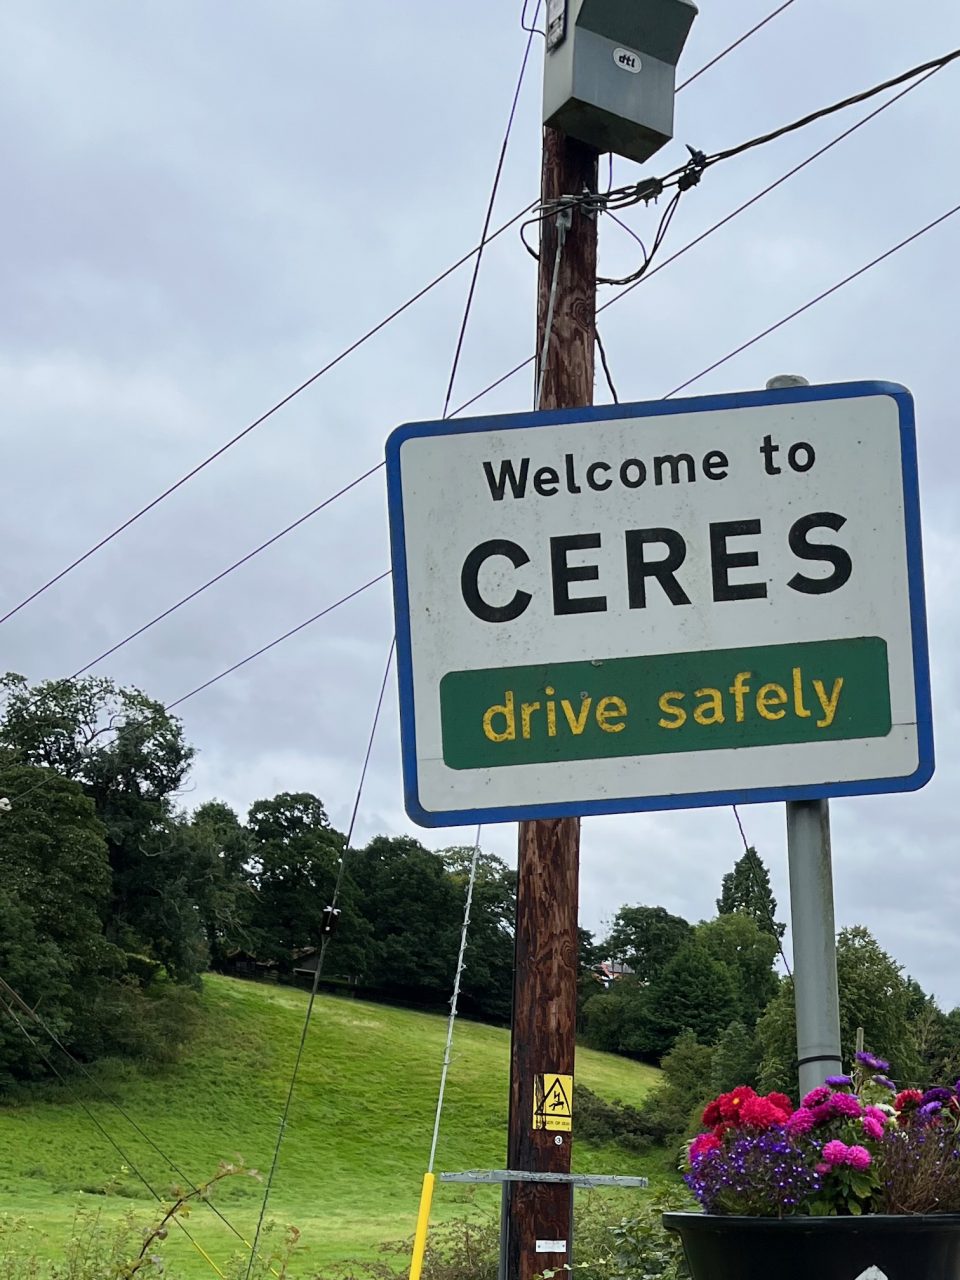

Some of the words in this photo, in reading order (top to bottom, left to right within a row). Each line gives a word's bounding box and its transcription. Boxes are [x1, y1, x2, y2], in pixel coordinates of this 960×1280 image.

[483, 451, 729, 501] Welcome
[760, 434, 816, 475] to
[460, 512, 853, 624] CERES
[482, 688, 628, 742] drive
[658, 667, 844, 729] safely
